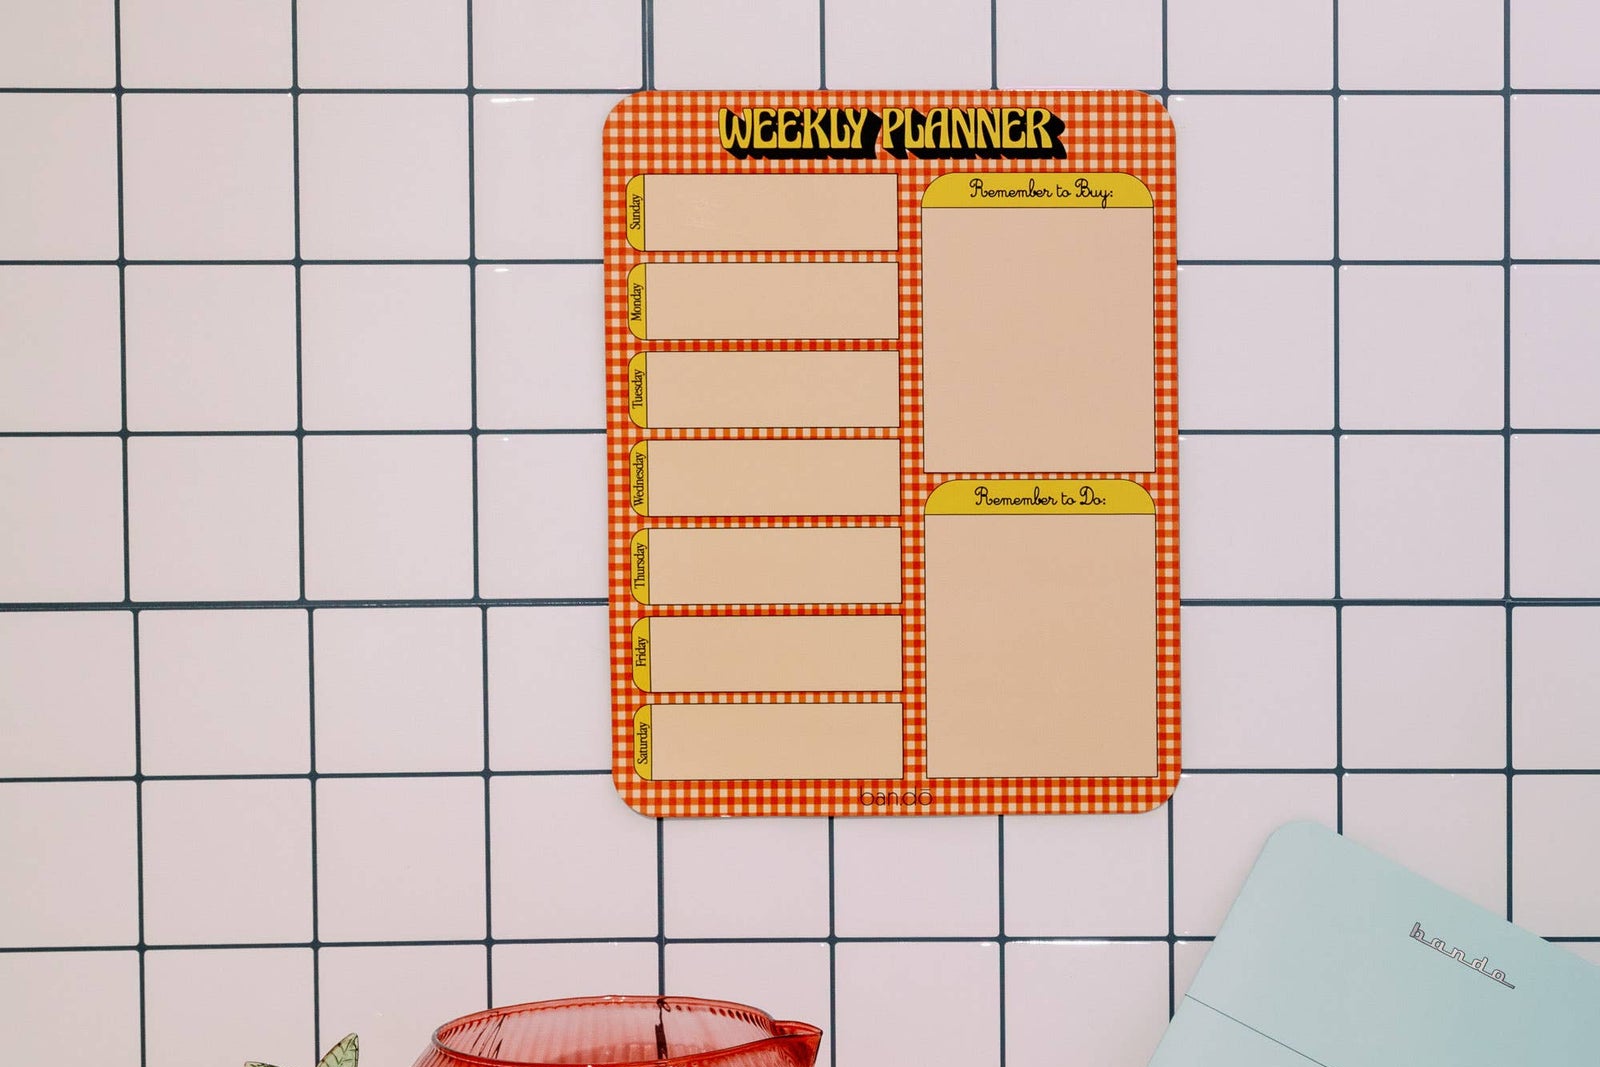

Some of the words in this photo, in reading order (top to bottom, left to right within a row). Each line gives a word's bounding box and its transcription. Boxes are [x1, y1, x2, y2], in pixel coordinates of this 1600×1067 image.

[718, 107, 876, 158] WEEKLY
[881, 107, 1066, 159] PLANNER
[629, 193, 643, 230] Sunday
[969, 178, 1053, 198] Remember
[1056, 183, 1072, 198] to
[1074, 178, 1114, 209] Buy:
[630, 282, 645, 322] Monday
[631, 368, 646, 410] Tuesday
[633, 451, 648, 507] Wednesday
[974, 486, 1058, 506] Remember
[1061, 491, 1076, 506] to
[1079, 485, 1107, 506] Do:
[634, 541, 648, 590] Thursday
[635, 635, 649, 667] Friday
[636, 721, 651, 765] Saturday
[1409, 921, 1516, 990] bando
